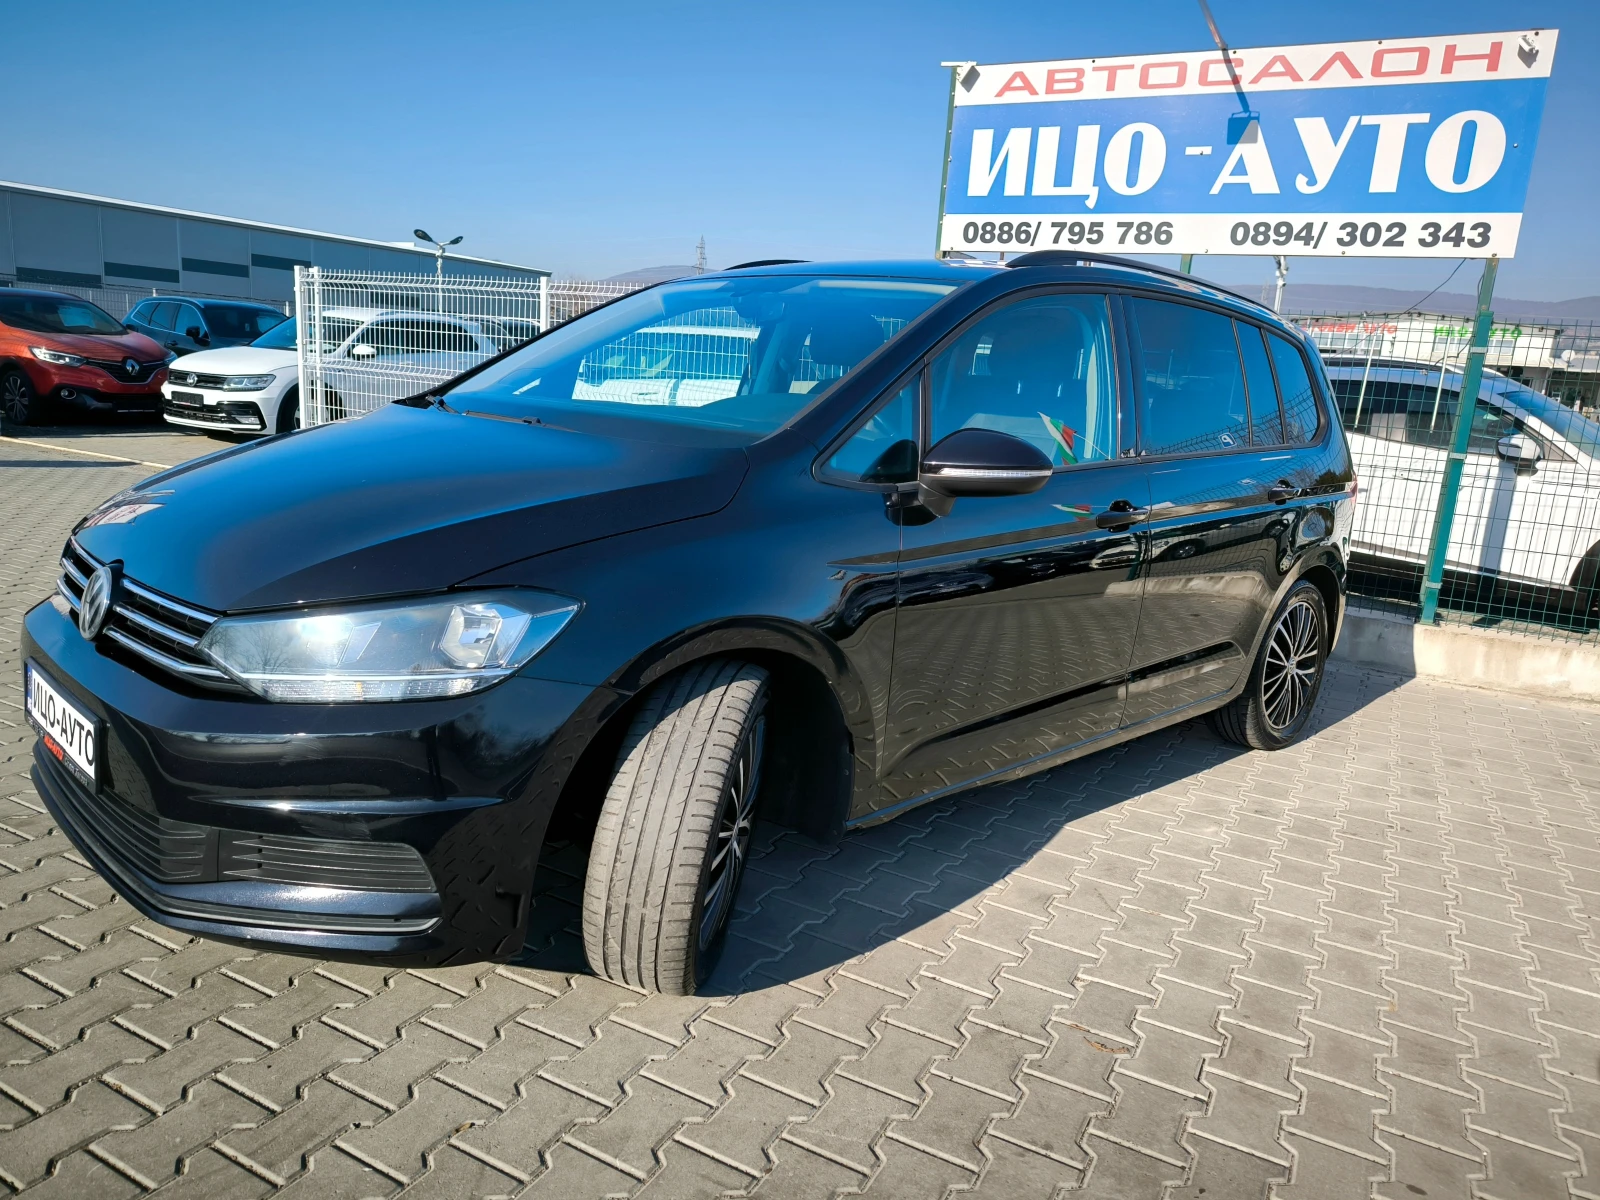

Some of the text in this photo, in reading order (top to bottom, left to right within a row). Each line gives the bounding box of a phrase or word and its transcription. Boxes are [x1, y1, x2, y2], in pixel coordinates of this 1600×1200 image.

[994, 42, 1502, 97] АВТОСАЛОН
[962, 222, 1174, 246] 0886/ 795 786
[1230, 222, 1491, 248] 0894/ 302 343
[33, 677, 95, 767] ИЦО-АУТО
